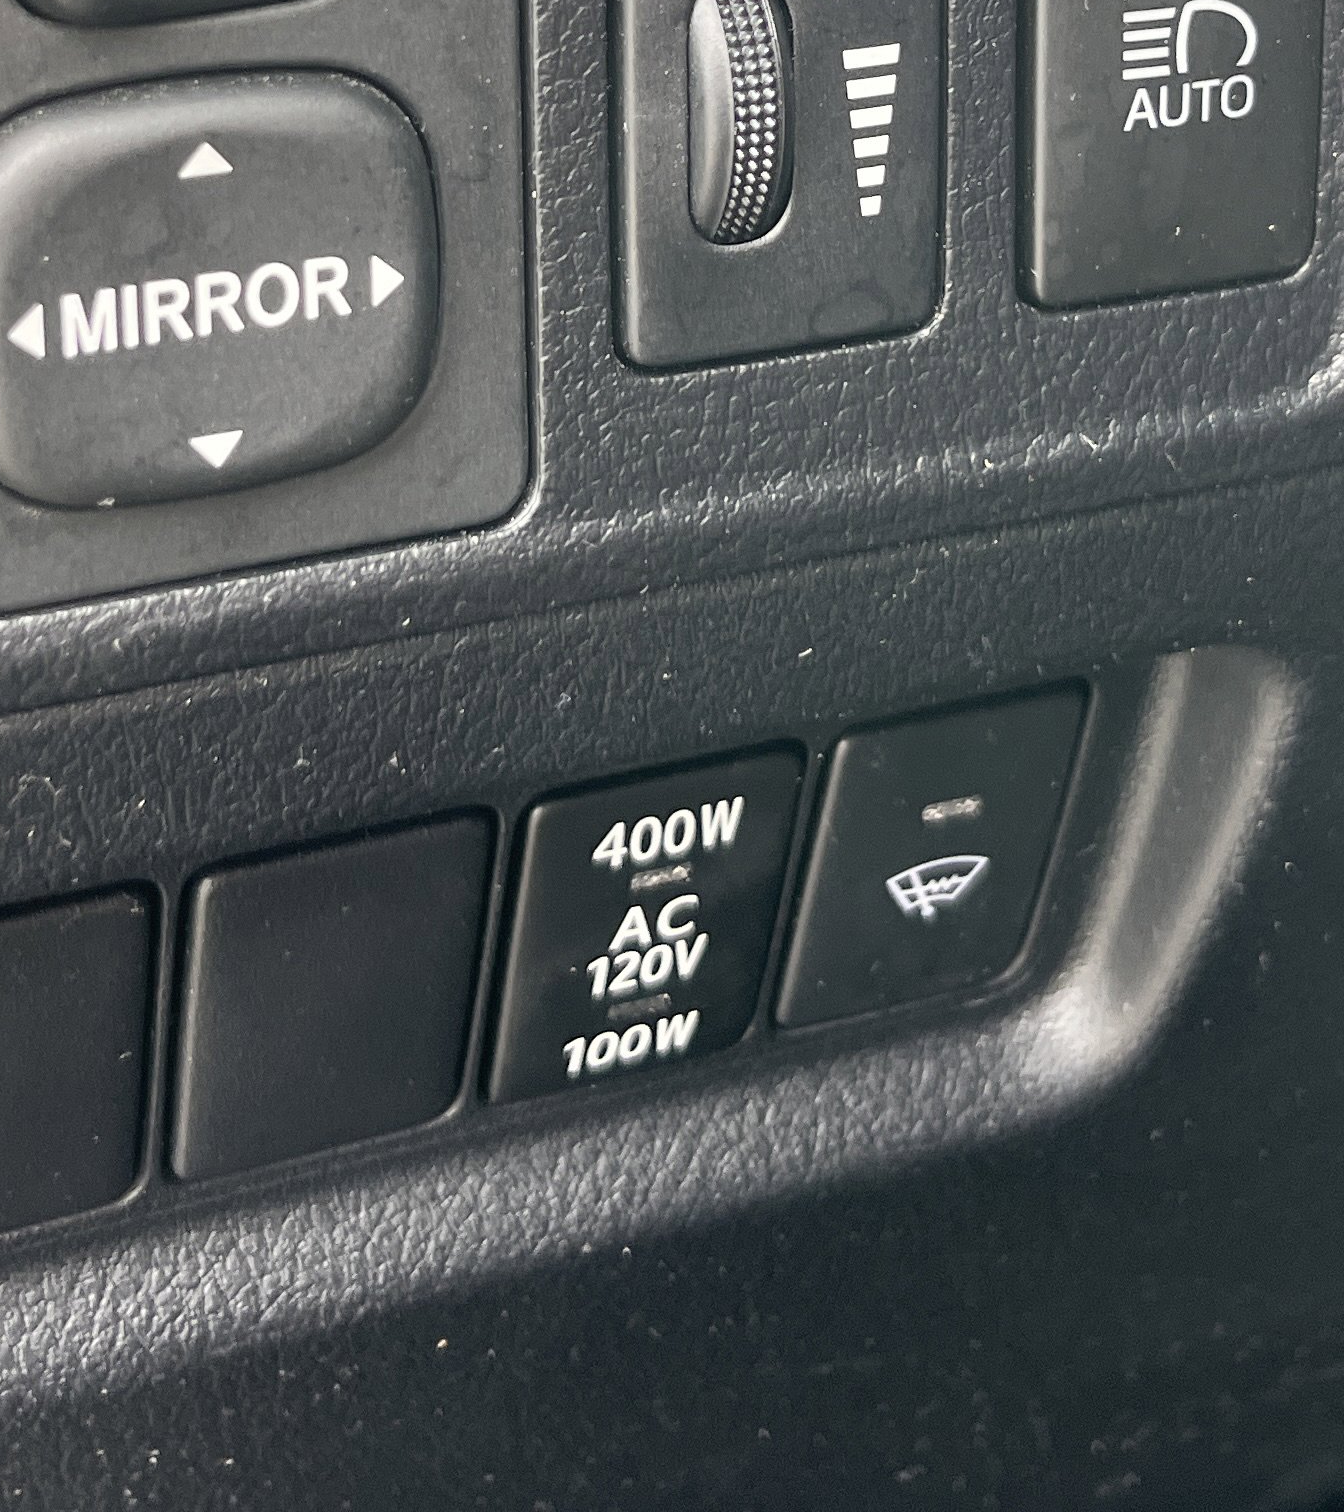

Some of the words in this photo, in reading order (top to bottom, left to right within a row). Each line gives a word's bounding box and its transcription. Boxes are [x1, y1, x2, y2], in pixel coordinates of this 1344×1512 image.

[1121, 73, 1256, 133] AUTO
[58, 254, 353, 361] MIRROR
[590, 795, 746, 872] 400W
[607, 894, 700, 954] AC
[586, 932, 711, 1001] 120V
[562, 1008, 702, 1080] 100W
